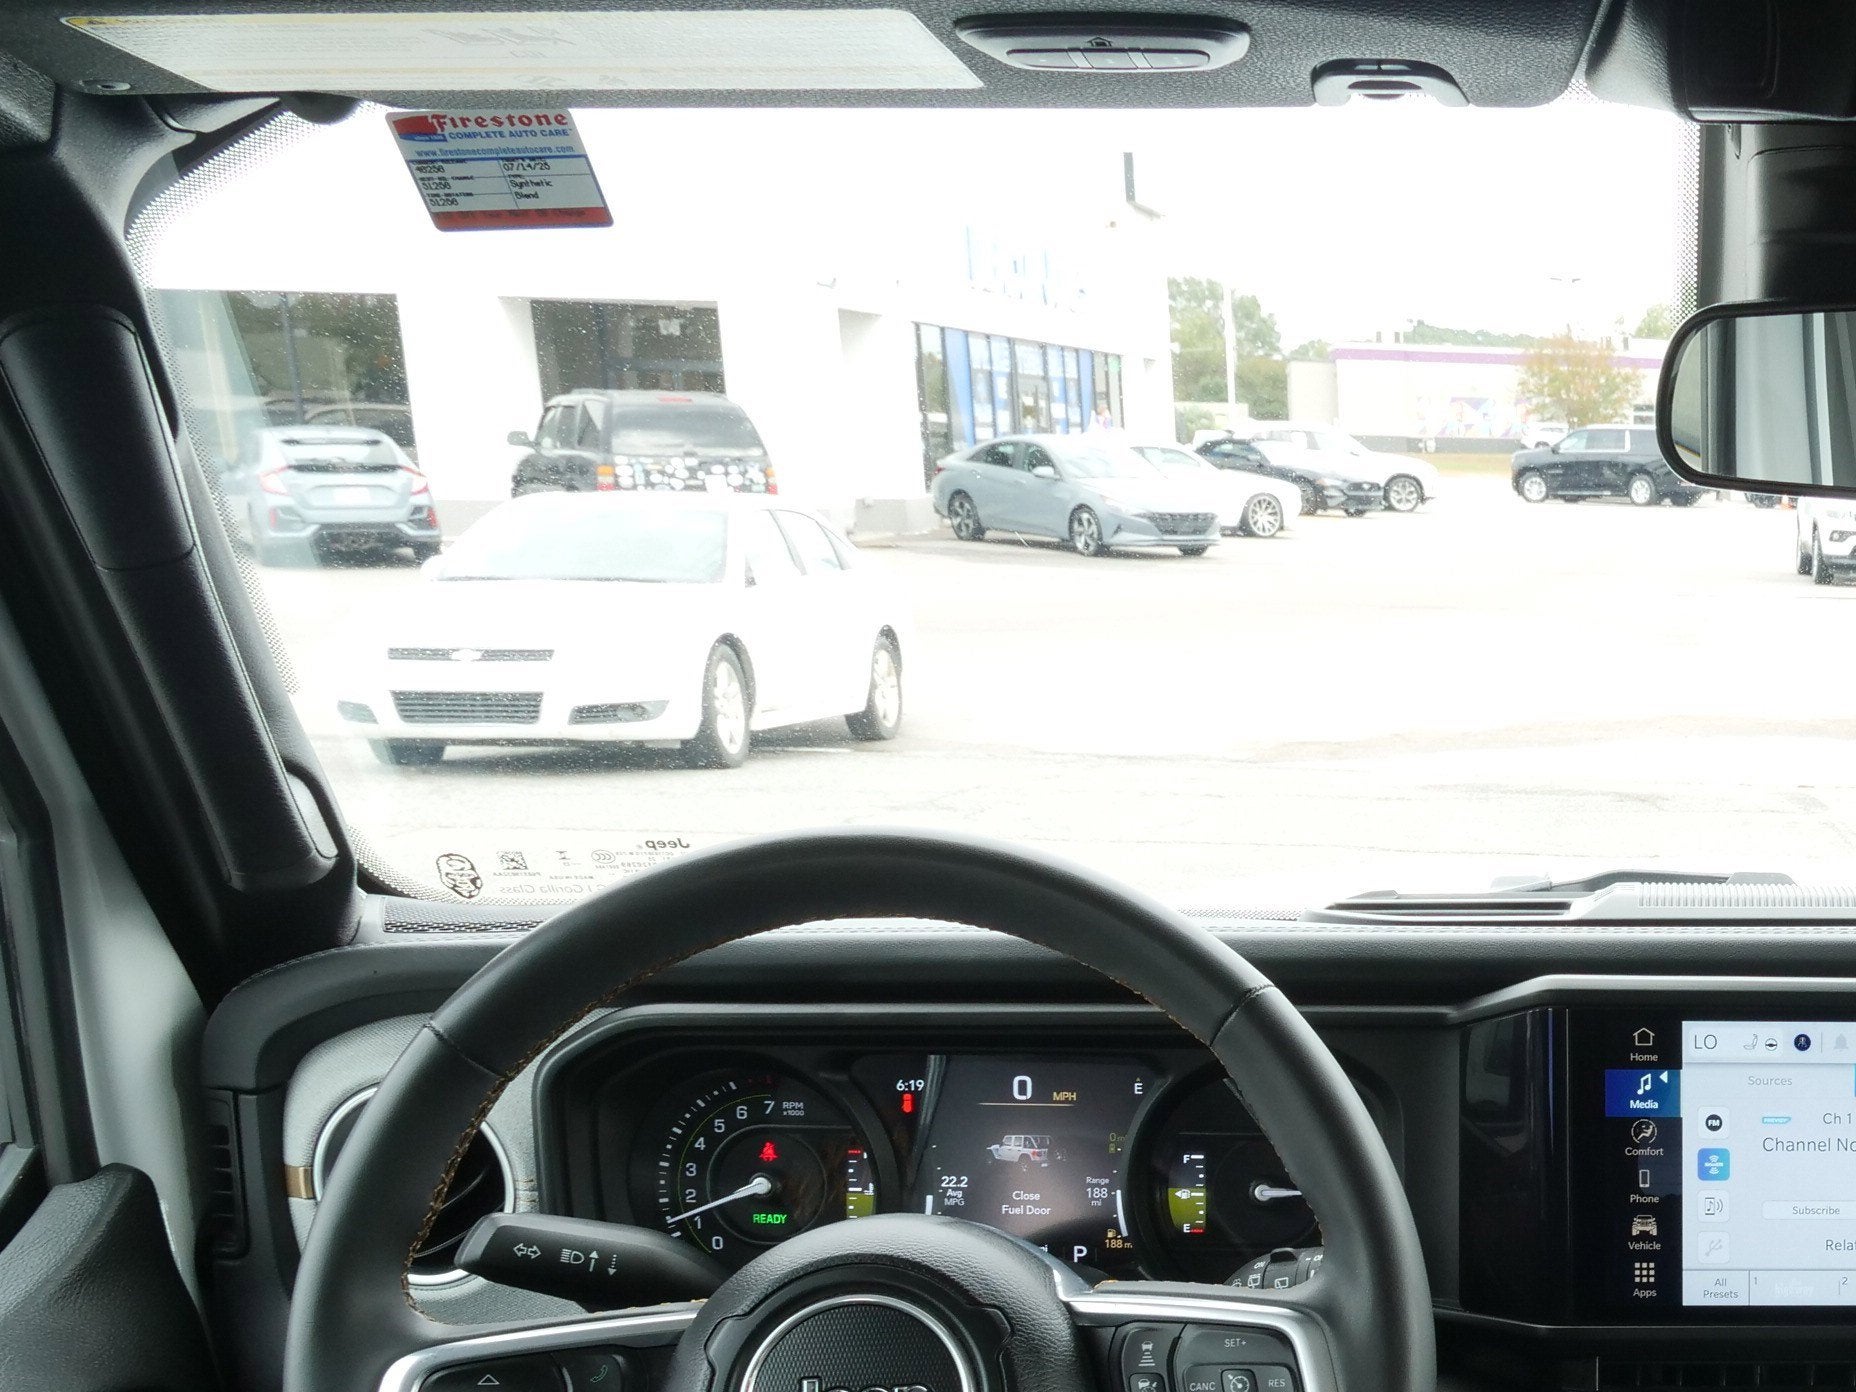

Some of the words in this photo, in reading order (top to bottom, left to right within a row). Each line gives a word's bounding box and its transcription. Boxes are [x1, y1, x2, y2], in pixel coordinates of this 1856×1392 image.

[431, 112, 569, 133] Firestone
[449, 130, 505, 140] COMPLETE
[509, 129, 538, 138] AUTO
[540, 128, 570, 138] CARE
[509, 178, 553, 189] Synthetic
[514, 192, 540, 200] Blend
[1693, 1034, 1718, 1050] LO
[1629, 1053, 1659, 1062] Home
[896, 1080, 925, 1092] 6:19
[1747, 1075, 1793, 1087] Sources
[1012, 1075, 1033, 1100] 0
[1052, 1092, 1077, 1102] MPH
[1134, 1082, 1144, 1095] E
[763, 1100, 775, 1115] 7
[782, 1102, 804, 1110] RPM
[1629, 1098, 1659, 1110] Media
[736, 1106, 748, 1120] 6
[1822, 1112, 1842, 1125] Ch
[1846, 1112, 1852, 1124] 1
[714, 1118, 726, 1132] 5
[1708, 1119, 1721, 1127] FM
[694, 1137, 706, 1151] 4
[1762, 1136, 1832, 1153] Channel
[1624, 1146, 1664, 1157] Comfort
[1183, 1154, 1191, 1164] F
[686, 1162, 697, 1176] 3
[941, 1176, 968, 1188] 22.2
[1086, 1176, 1110, 1185] Range
[686, 1189, 696, 1203] 2
[946, 1188, 963, 1198] Avg
[1012, 1190, 1041, 1201] Close
[1086, 1187, 1108, 1199] 188
[944, 1198, 965, 1206] MPG
[1630, 1194, 1660, 1204] Phone
[1002, 1204, 1024, 1215] Fuel
[1026, 1204, 1052, 1215] Door
[1792, 1205, 1841, 1216] Subscribe
[752, 1213, 788, 1224] READY
[1183, 1223, 1191, 1233] E
[712, 1236, 723, 1250] 0
[1104, 1239, 1123, 1249] 188
[1628, 1240, 1662, 1251] Vehicle
[1073, 1246, 1088, 1263] P
[1714, 1278, 1727, 1287] All
[1841, 1276, 1848, 1286] 2
[1632, 1288, 1657, 1299] Apps
[1703, 1289, 1739, 1299] Presets
[1189, 1382, 1216, 1392] CANC
[1268, 1378, 1286, 1388] RES
